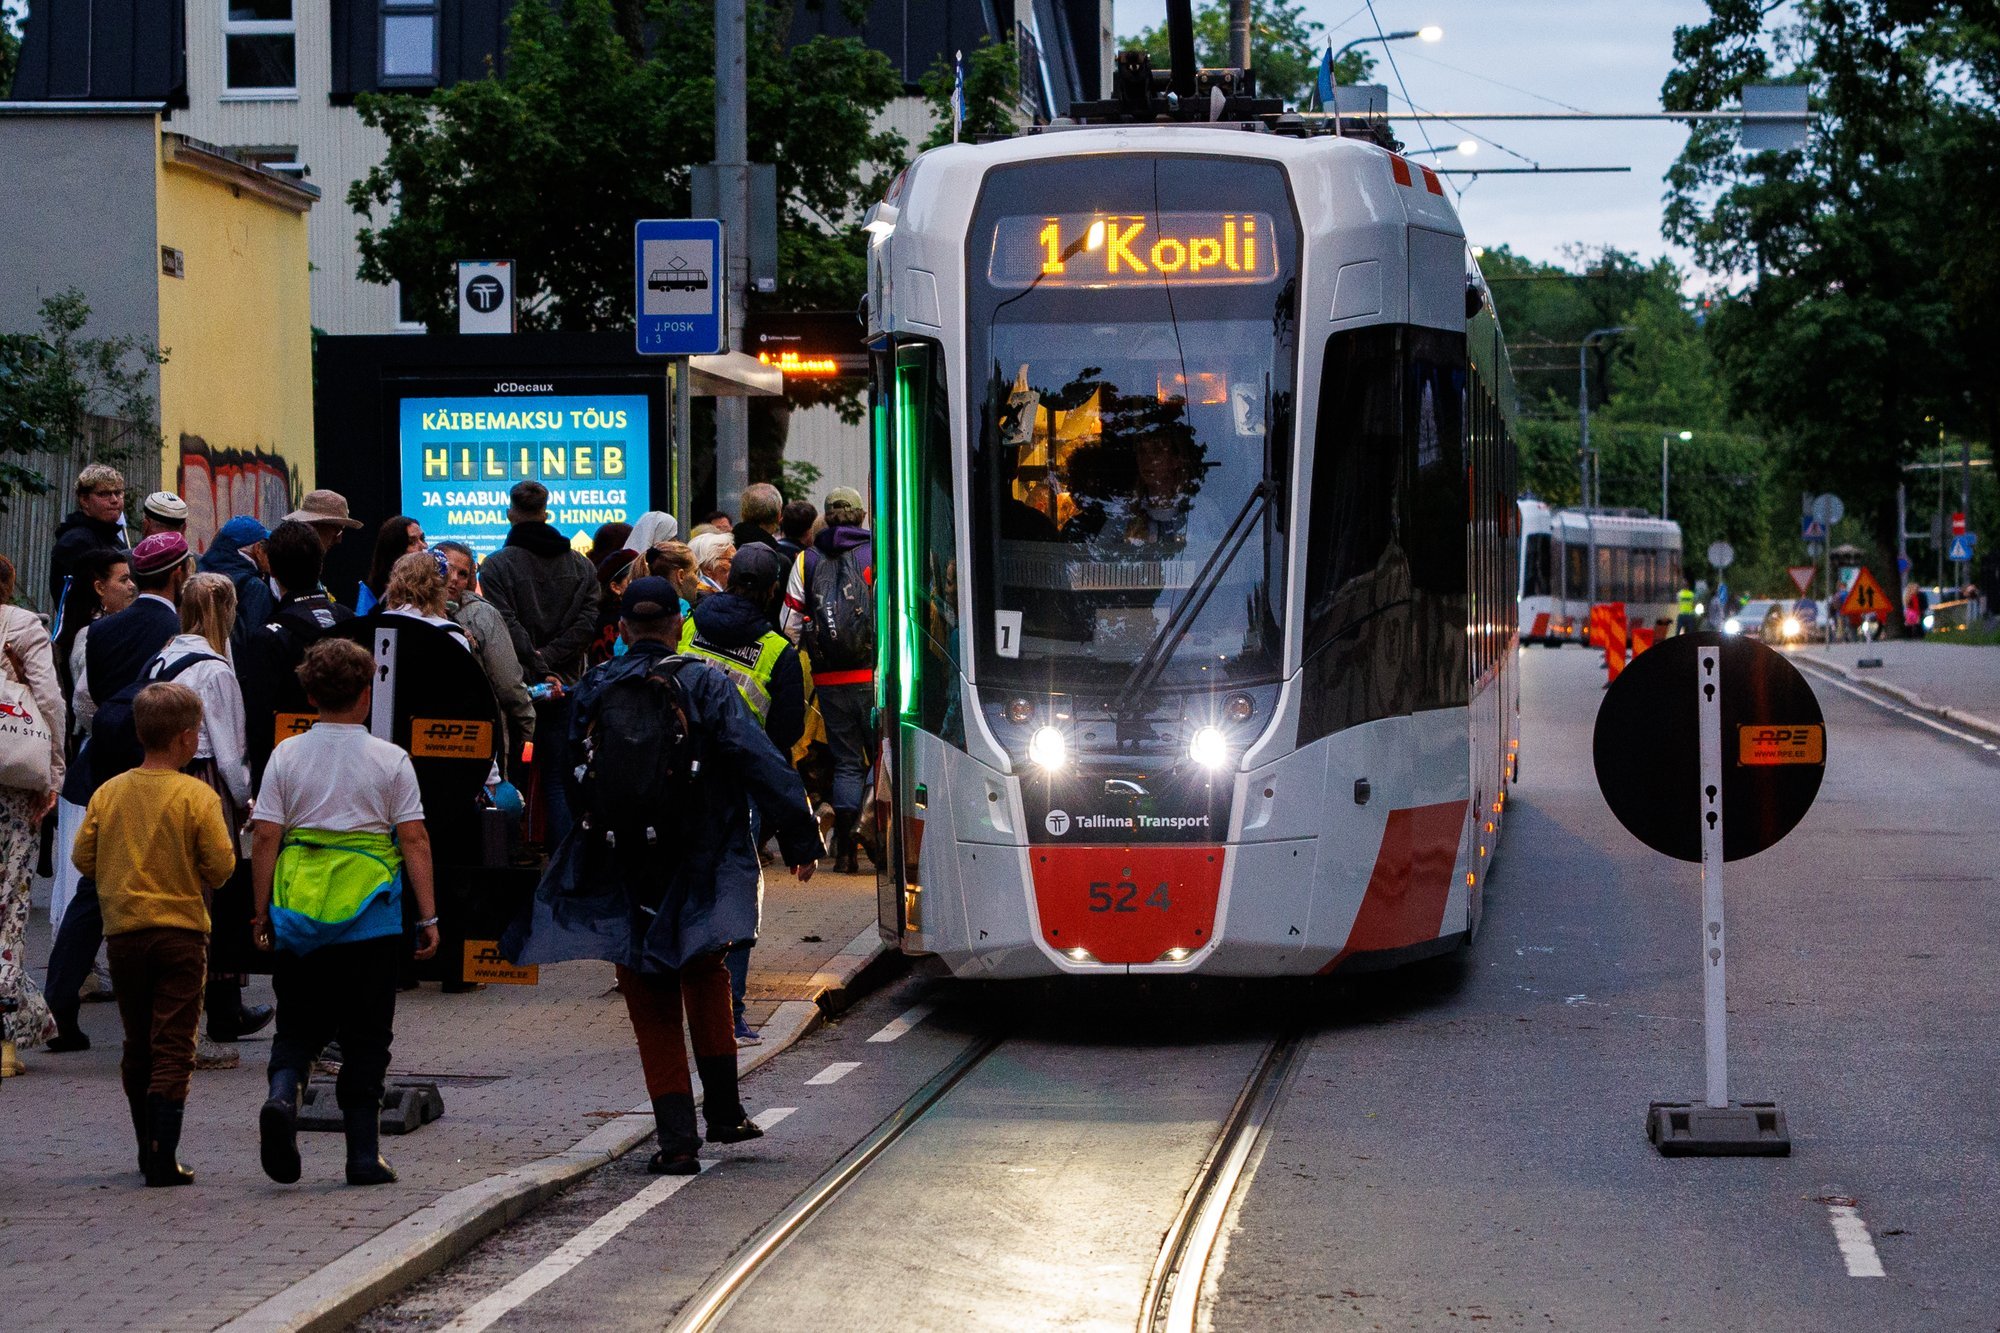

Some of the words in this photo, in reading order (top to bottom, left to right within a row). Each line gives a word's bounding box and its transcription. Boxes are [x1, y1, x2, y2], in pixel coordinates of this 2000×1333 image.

[1039, 223, 1065, 273] 1
[1107, 222, 1255, 273] Kopli
[654, 321, 694, 332] J.POSK
[655, 334, 662, 344] 3
[493, 382, 554, 393] JCDecaux
[421, 408, 563, 430] KÄIBEMAKSU
[569, 407, 628, 430] TÕUS
[424, 446, 624, 476] HILINEB
[422, 491, 442, 507] JA
[445, 491, 511, 506] SAABUM
[569, 489, 627, 505] VEELGI
[560, 508, 627, 525] HINNAD
[1001, 626, 1011, 649] 1
[1076, 815, 1133, 828] Tallinna
[1137, 814, 1210, 830] Transport
[1088, 881, 1172, 913] 524
